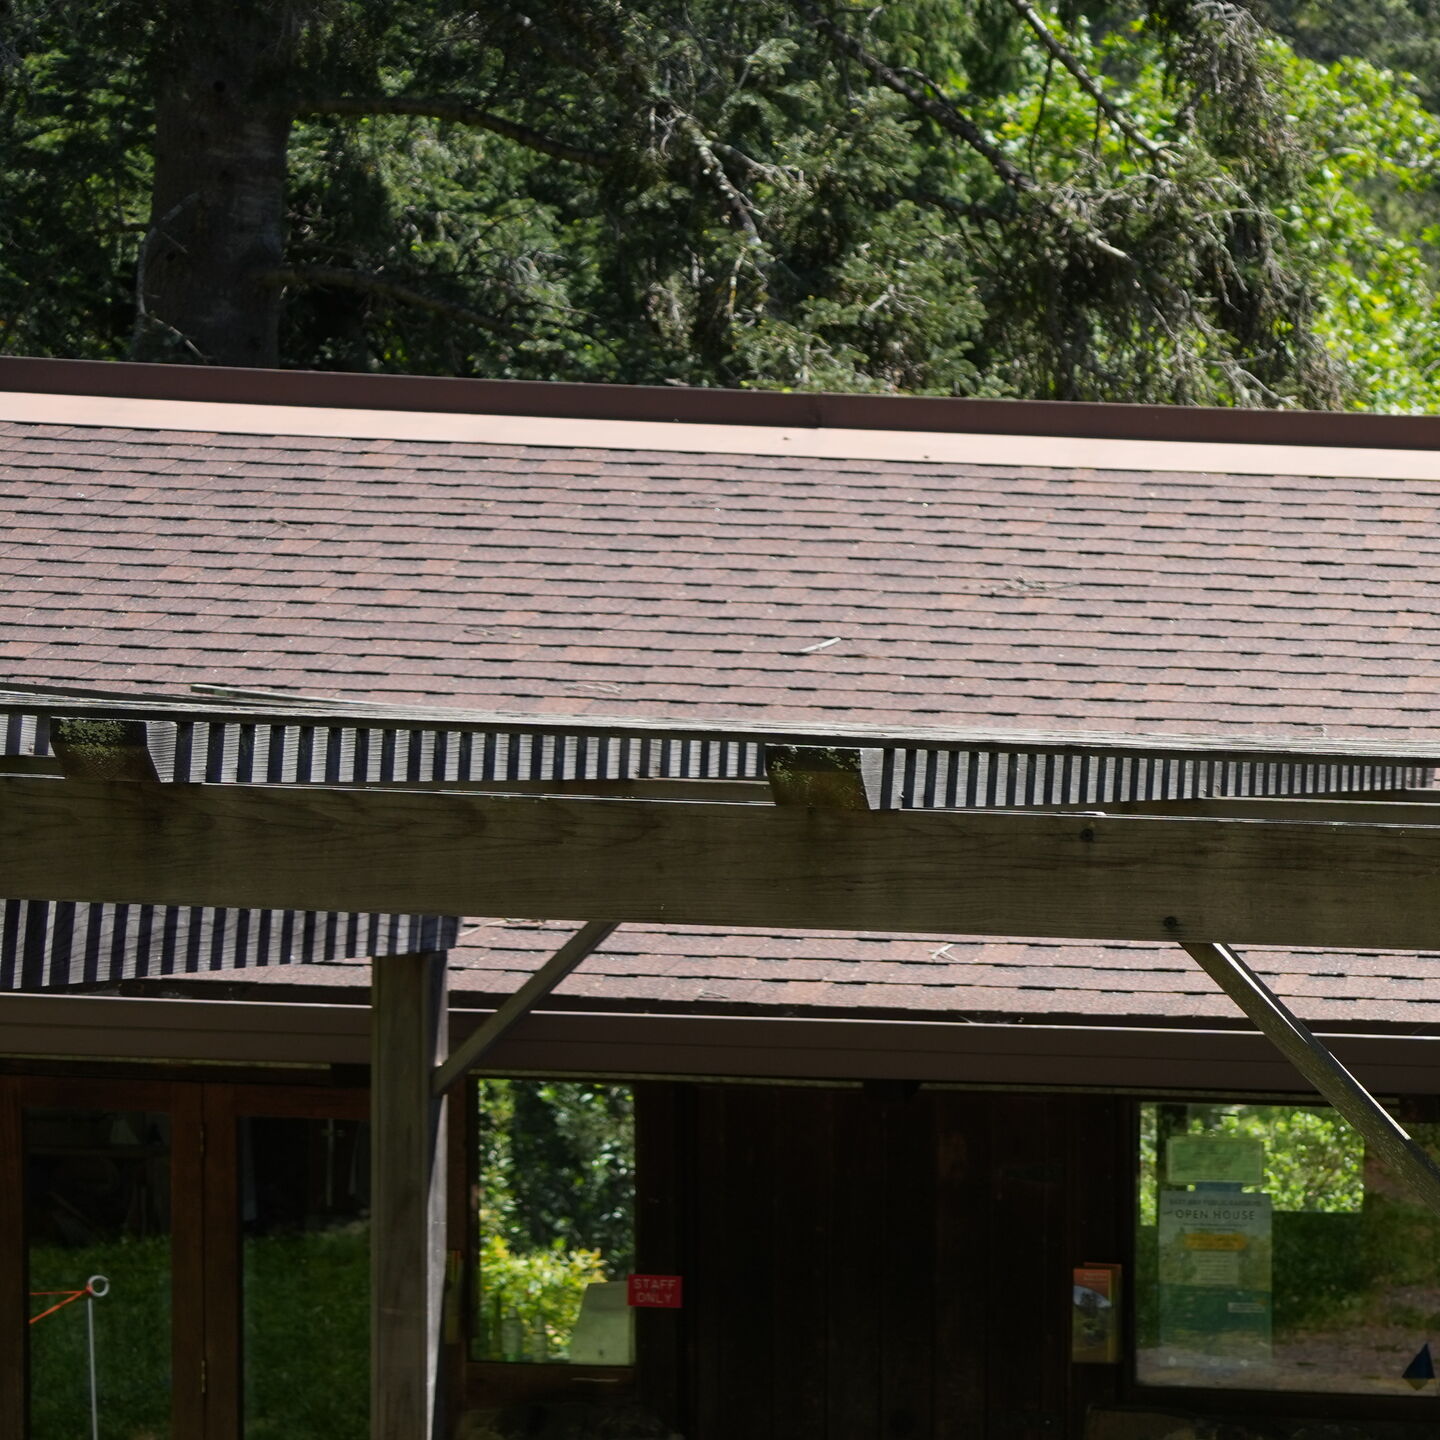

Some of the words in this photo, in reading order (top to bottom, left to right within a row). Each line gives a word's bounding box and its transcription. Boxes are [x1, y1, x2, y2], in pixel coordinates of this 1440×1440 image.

[1175, 1209, 1209, 1219] OPEN
[1213, 1210, 1255, 1220] HOUSE
[633, 1278, 676, 1290] STAFF
[635, 1292, 673, 1304] ONLY
